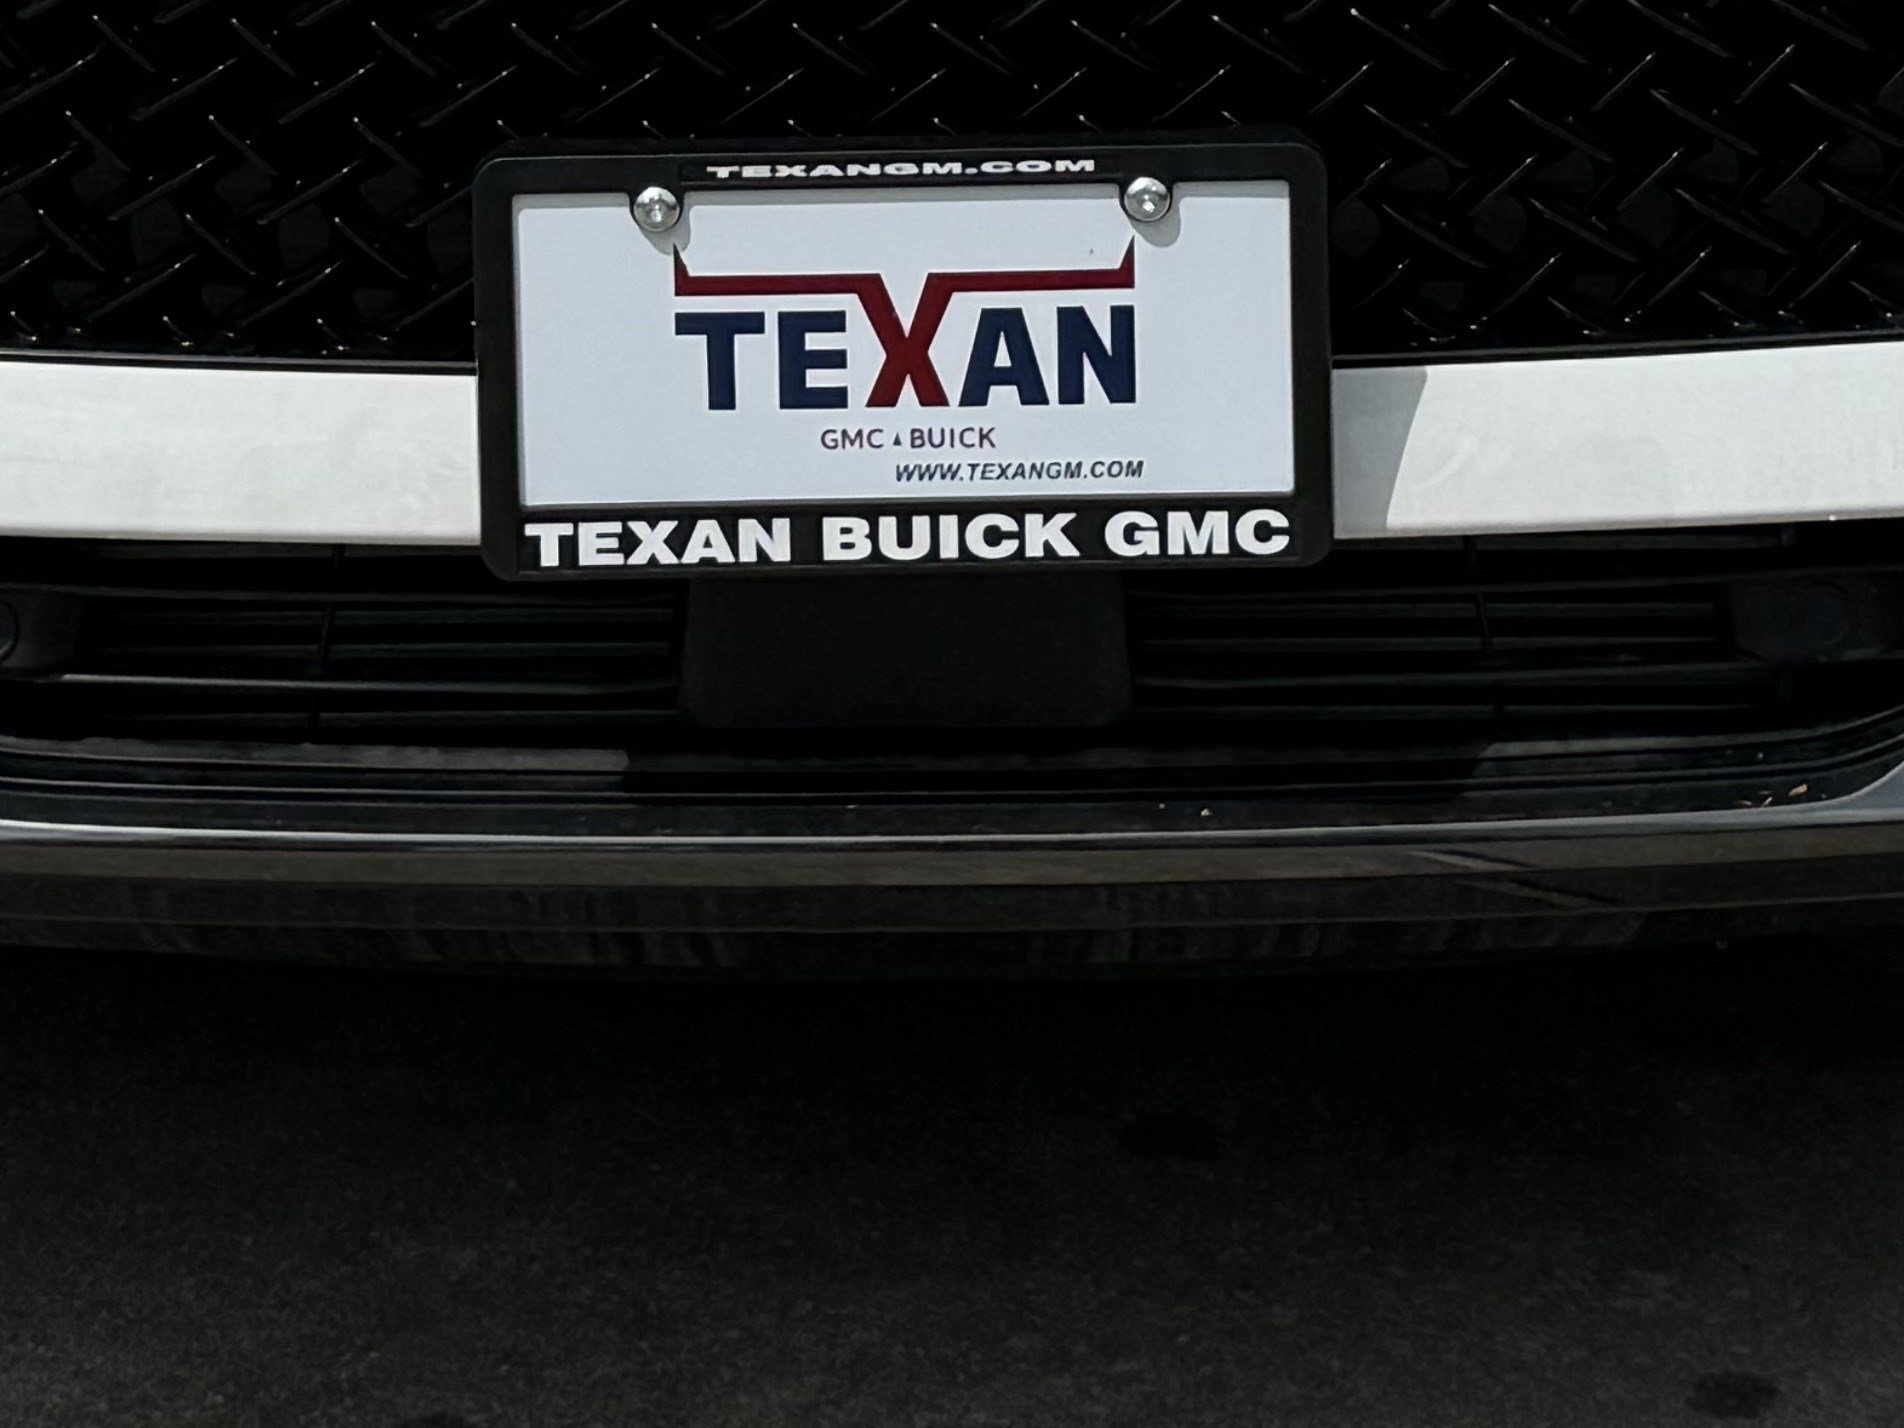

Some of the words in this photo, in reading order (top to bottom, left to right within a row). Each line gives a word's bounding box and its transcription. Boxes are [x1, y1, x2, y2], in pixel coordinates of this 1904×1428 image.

[705, 158, 1096, 179] TEXANGM.COM
[674, 272, 1137, 410] TEXAN
[819, 427, 885, 451] GMC
[909, 425, 998, 450] BUICK
[895, 459, 1145, 483] WWW.TEXANGM.COM
[523, 518, 792, 568] TEXAN
[821, 511, 1081, 562] BUICK
[1103, 507, 1291, 558] GMC
